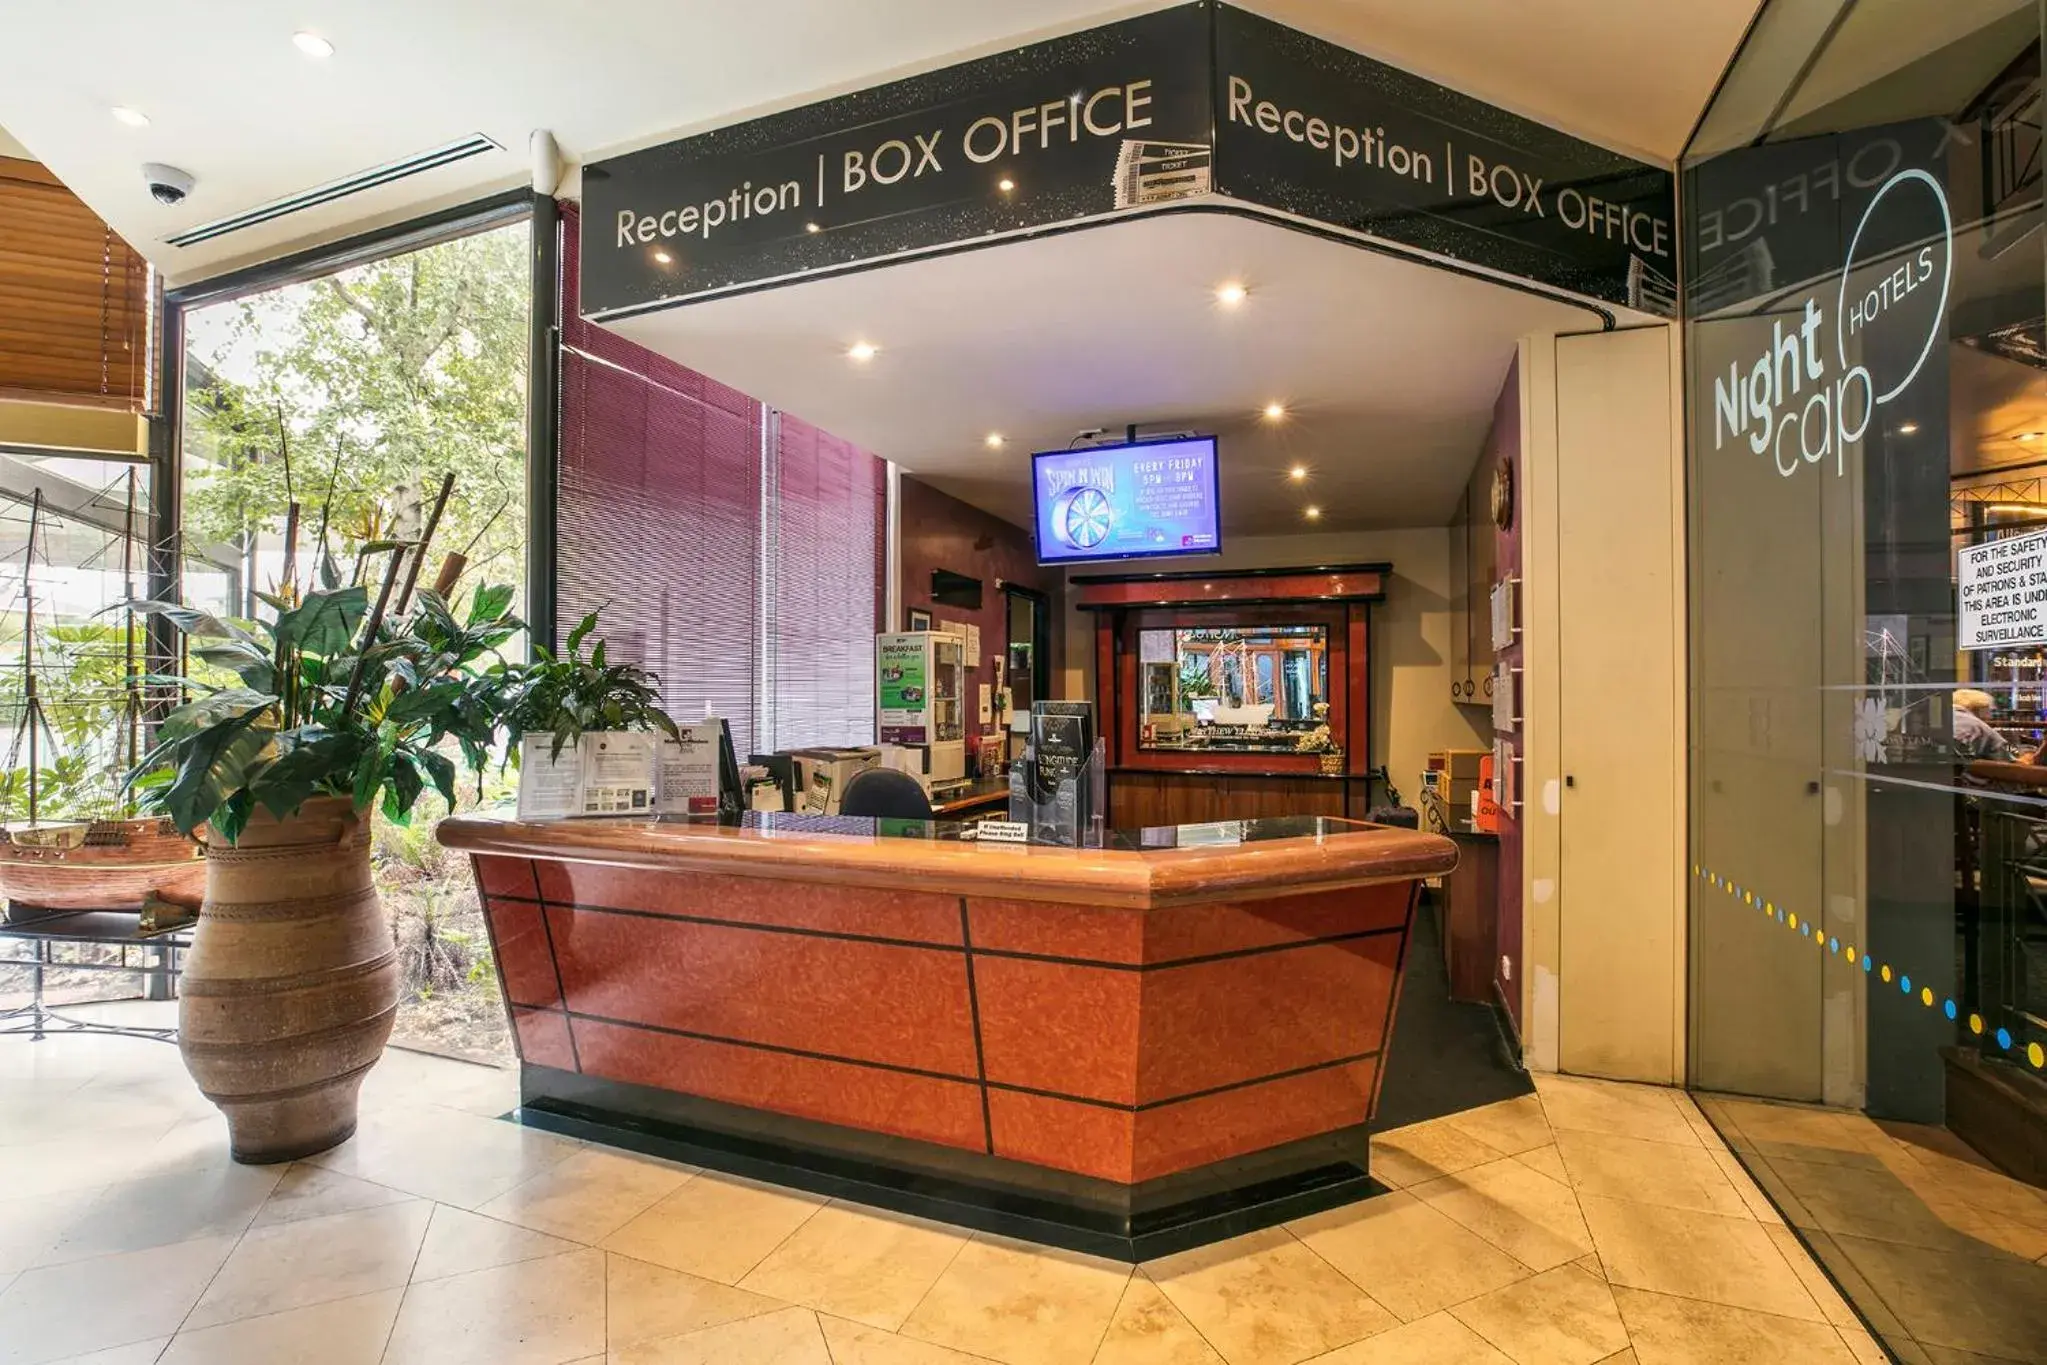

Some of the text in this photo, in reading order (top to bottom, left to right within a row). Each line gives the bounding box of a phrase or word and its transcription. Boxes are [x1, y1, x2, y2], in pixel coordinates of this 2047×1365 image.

[616, 79, 1153, 248] Reception BOX OFFICE
[1161, 160, 1188, 171] TICKET
[1228, 75, 1669, 258] Reception BOX OFFICE
[1850, 246, 1933, 335] HOTELS
[1714, 297, 1824, 455] Night
[1775, 365, 1872, 478] cap
[1133, 458, 1204, 474] EVERY FRIDAY
[1971, 537, 2047, 564] FOR THE SAFETY
[1976, 554, 2042, 579] AND SECURITY
[1963, 585, 1975, 597] OF
[1977, 577, 2016, 595] PATRONS
[2019, 575, 2026, 588] &
[1964, 598, 1983, 612] THIS
[1985, 595, 2009, 611] AREA
[2012, 592, 2021, 606] IS
[1980, 608, 2037, 627] ELECTRONIC
[1976, 624, 2044, 643] SURVEILLANCE
[883, 645, 922, 653] BREAKFAST
[1993, 656, 2042, 668] Standard
